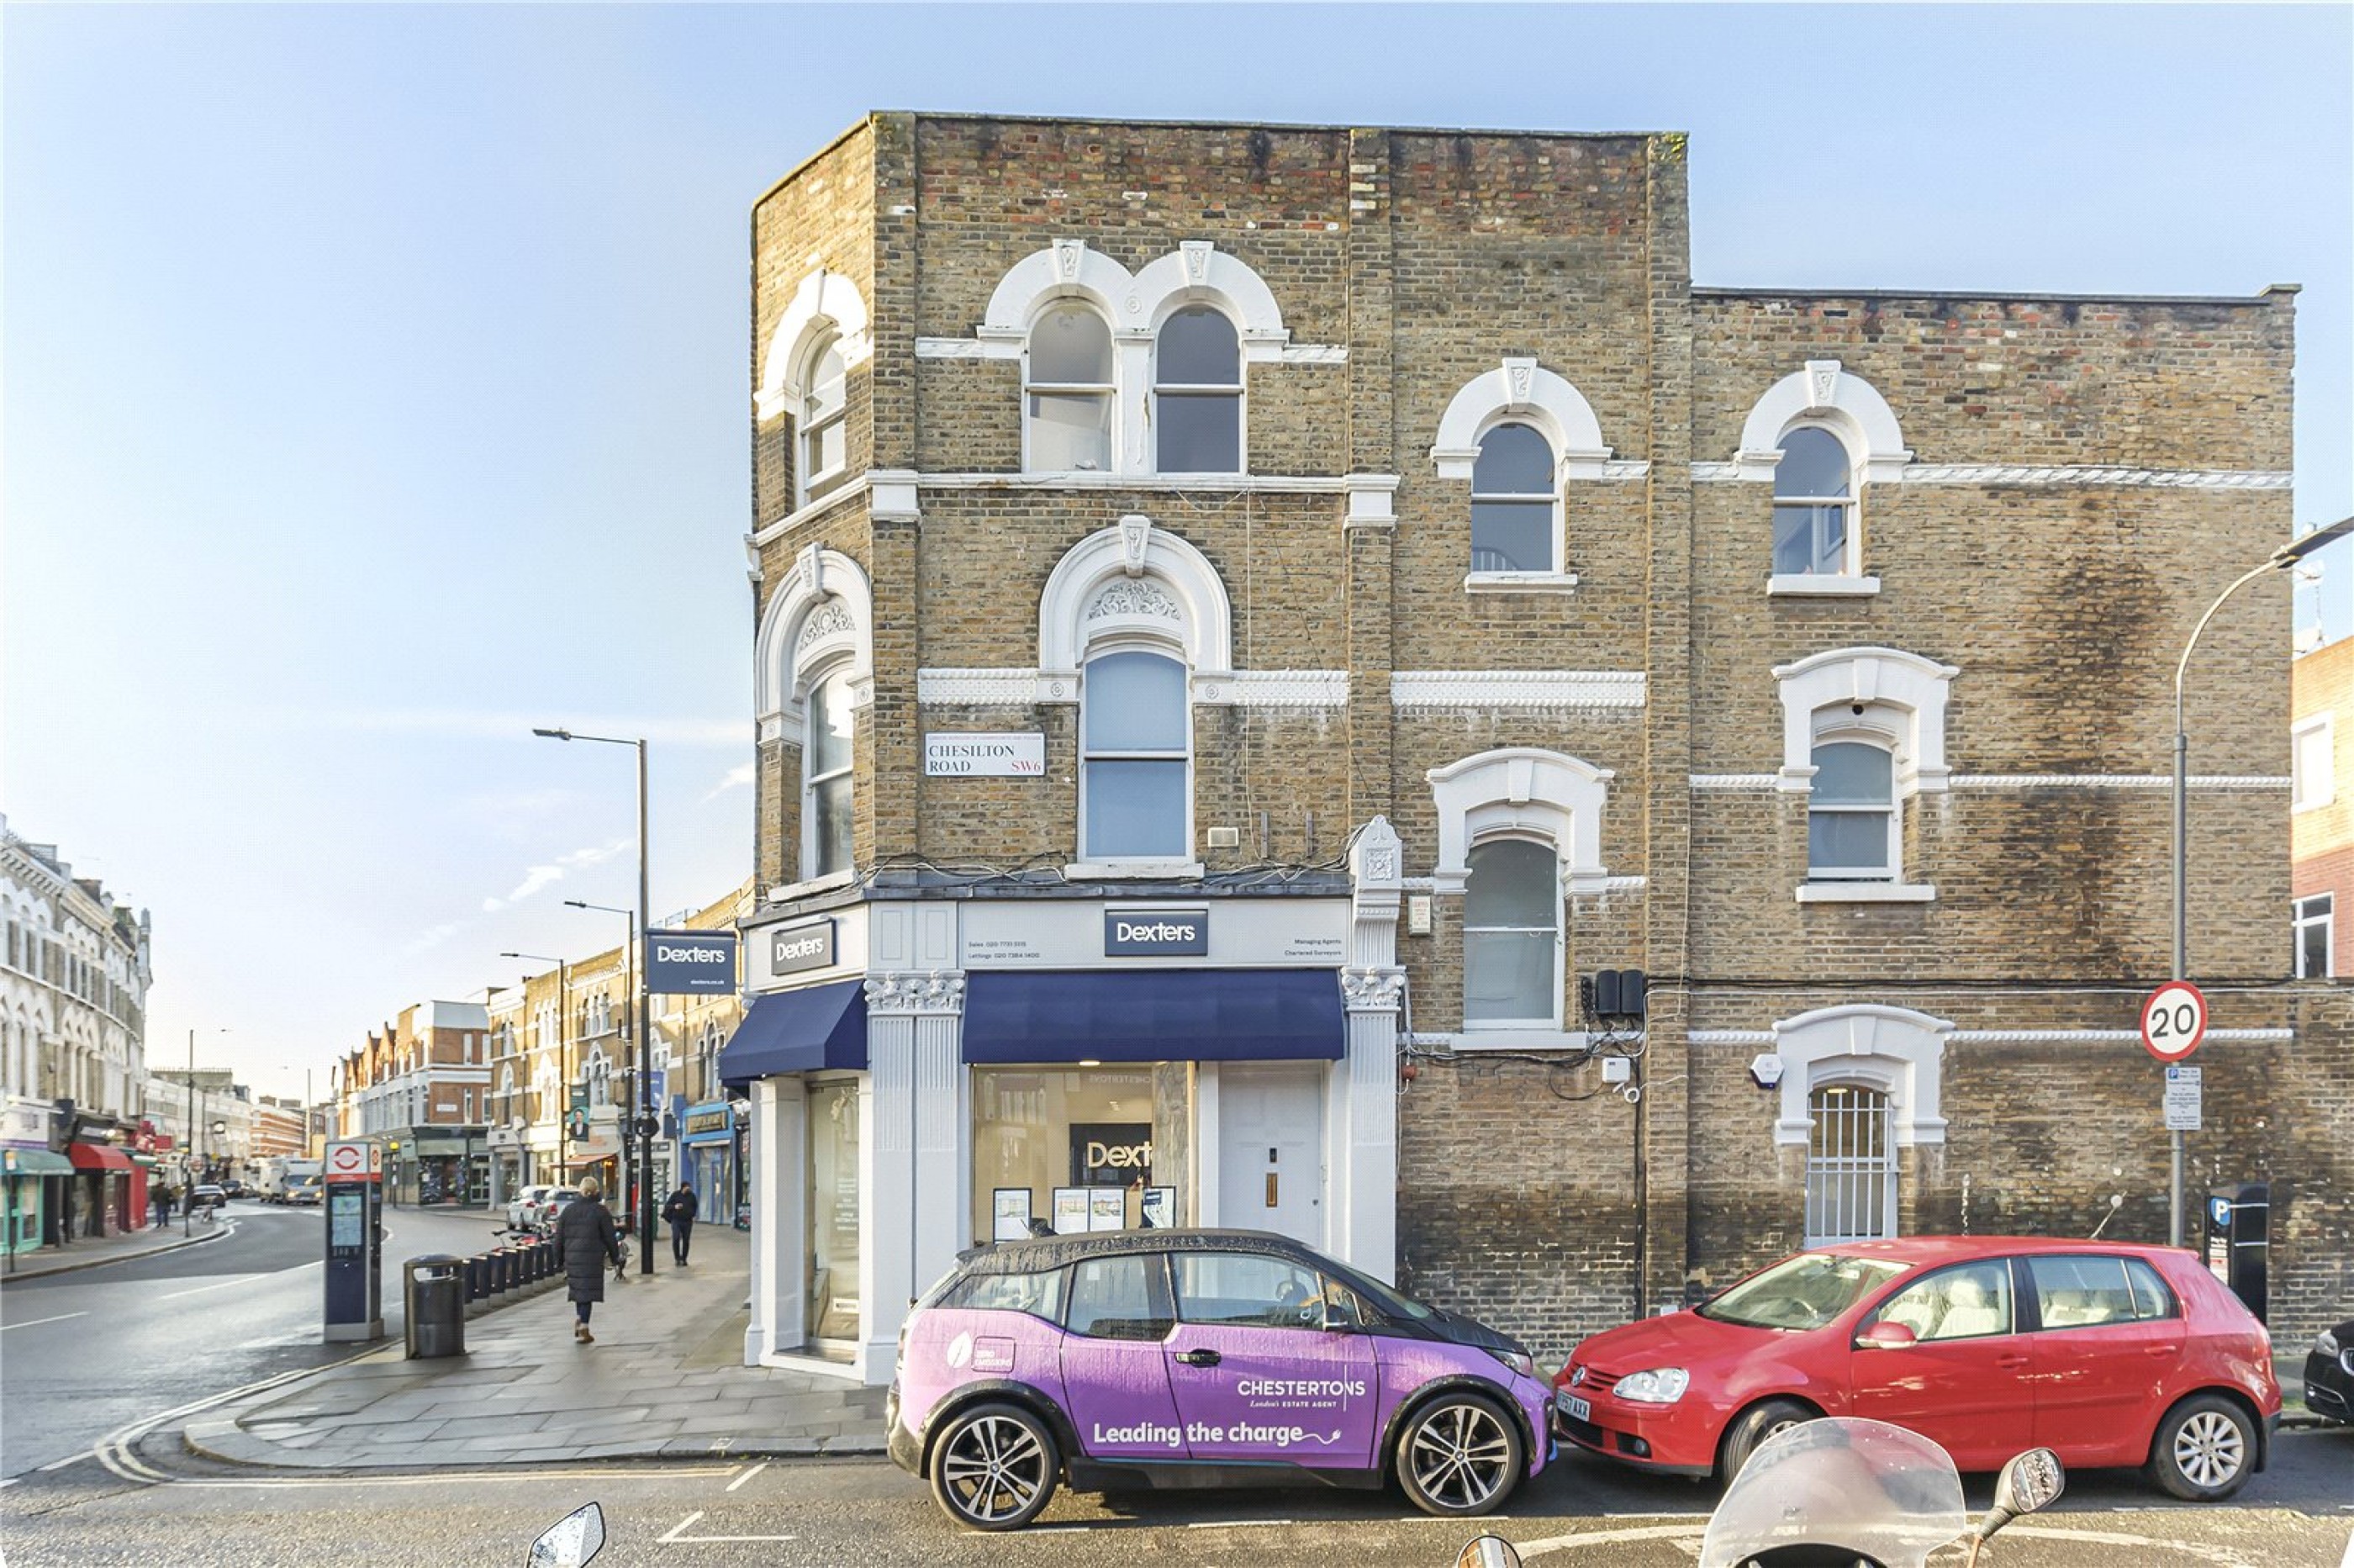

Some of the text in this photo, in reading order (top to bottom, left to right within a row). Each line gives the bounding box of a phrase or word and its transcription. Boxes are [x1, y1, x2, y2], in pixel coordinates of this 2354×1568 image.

[929, 745, 1015, 757] CHESILTON
[929, 760, 1041, 772] ROAD SW6
[1117, 921, 1195, 942] Dexters
[657, 945, 726, 963] Dexters
[776, 937, 824, 962] Dexters
[2151, 1003, 2195, 1038] 20
[1087, 1141, 1153, 1168] Dext
[2215, 1201, 2228, 1222] P
[1237, 1380, 1366, 1396] CHESTERTONS
[1249, 1400, 1280, 1408] London's
[1094, 1421, 1303, 1448] Leading the charge
